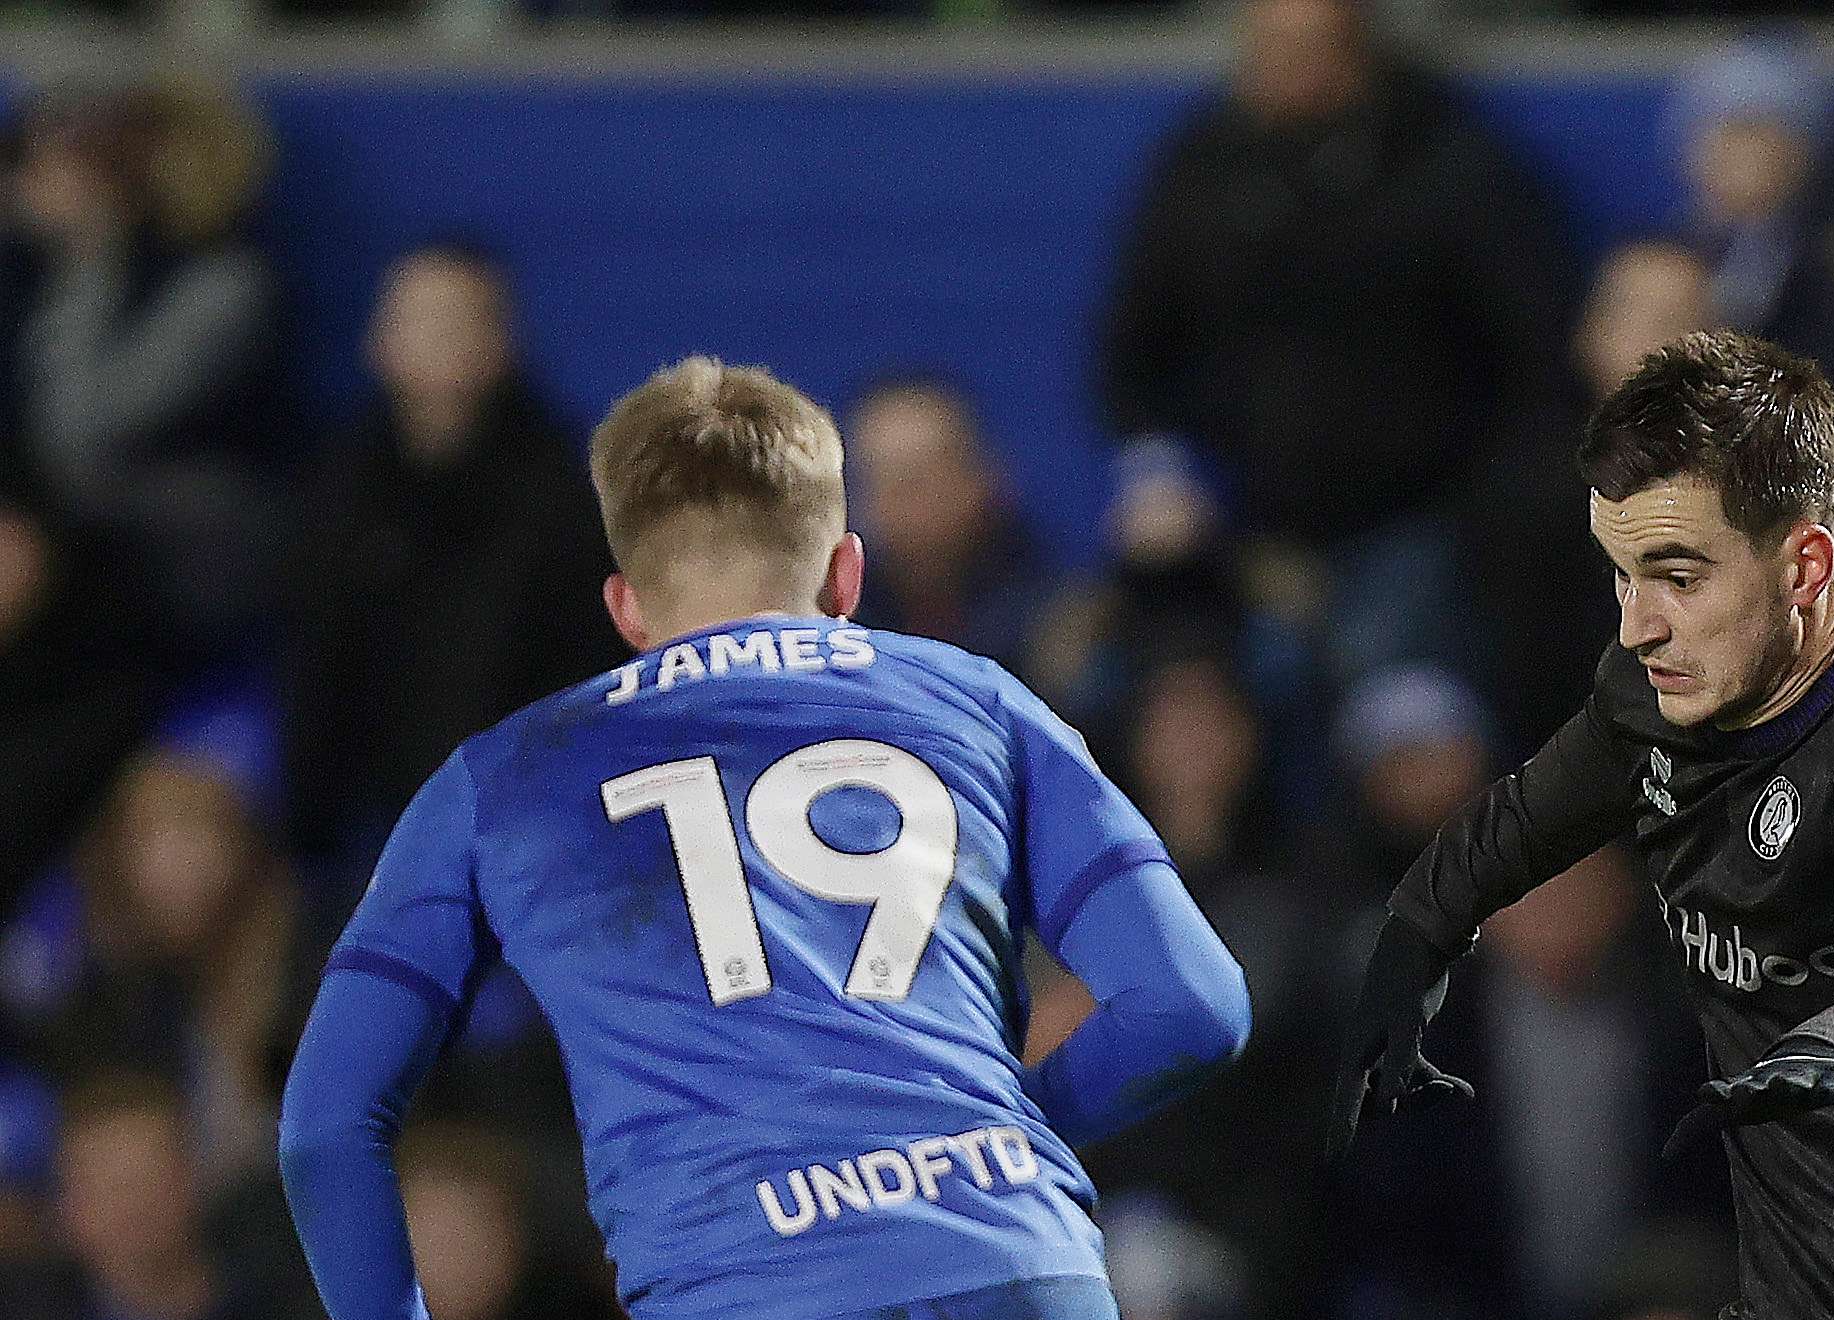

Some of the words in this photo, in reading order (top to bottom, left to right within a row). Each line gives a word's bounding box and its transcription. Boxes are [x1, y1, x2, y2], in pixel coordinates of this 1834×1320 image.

[604, 628, 875, 706] JAMES
[600, 739, 959, 1008] 19
[756, 1124, 1040, 1237] UNDFTD
